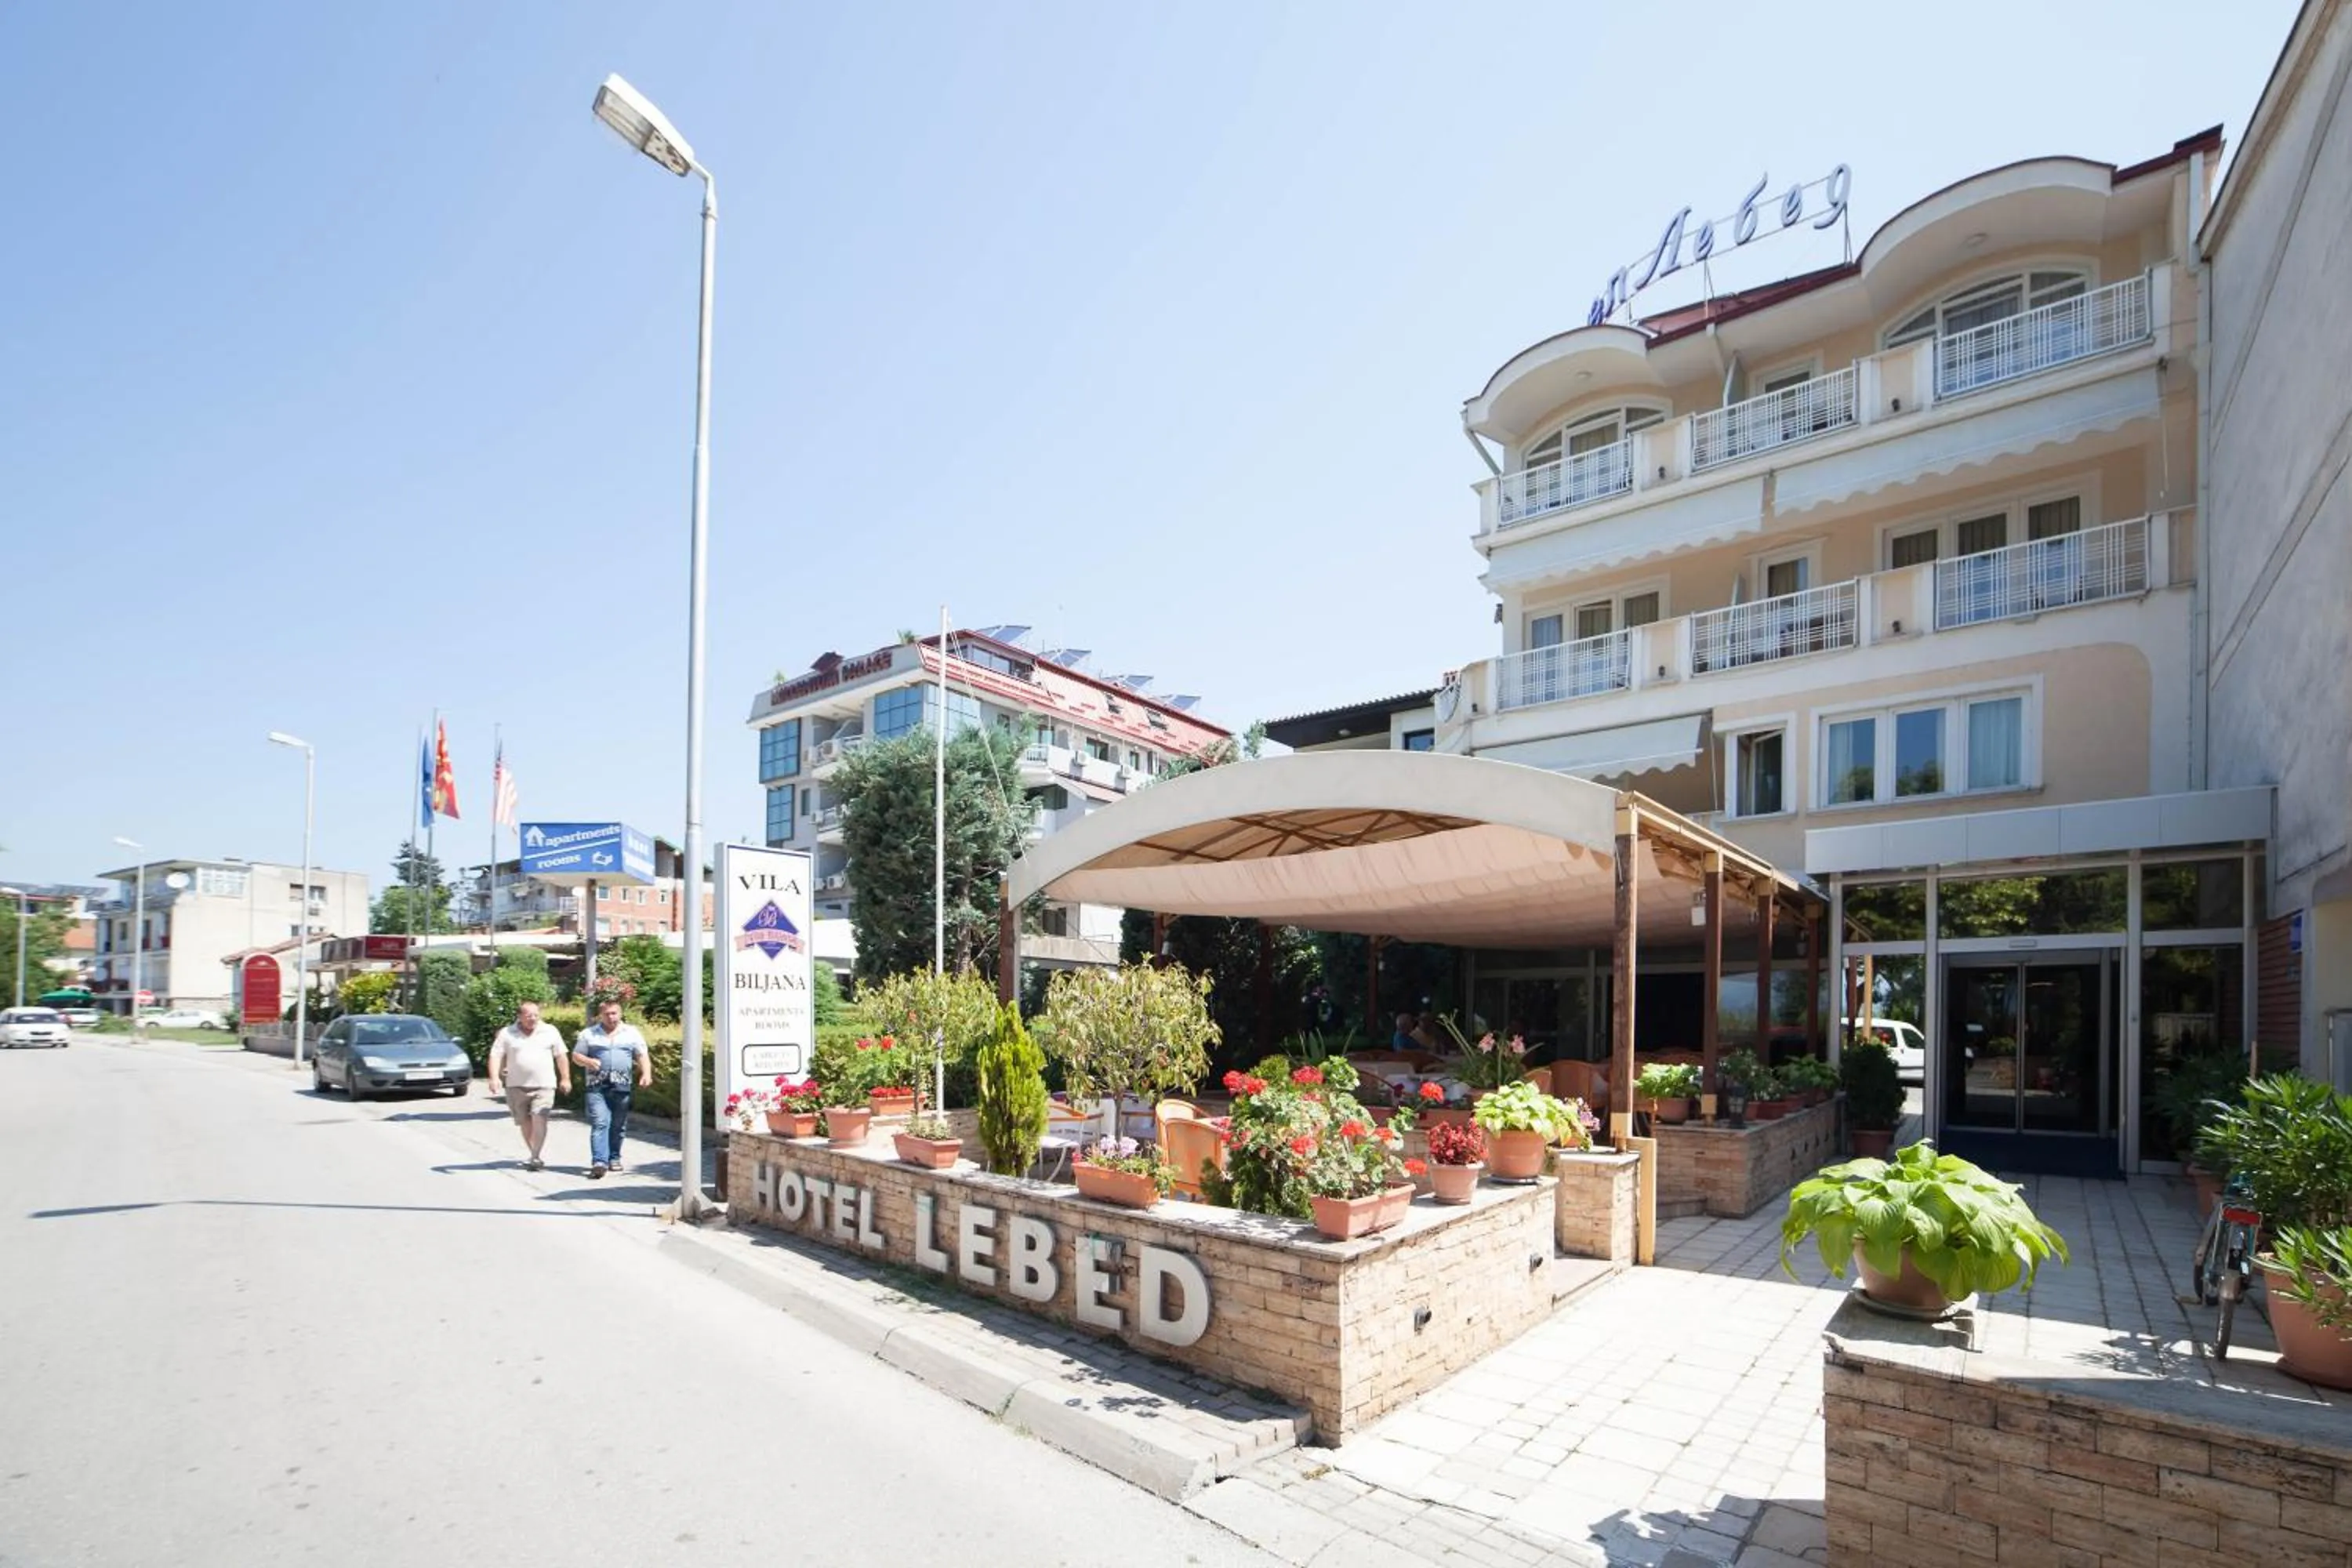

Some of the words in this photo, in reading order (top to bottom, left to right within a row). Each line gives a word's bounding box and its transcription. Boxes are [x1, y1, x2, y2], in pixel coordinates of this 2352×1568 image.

[545, 825, 621, 848] apartments
[537, 854, 582, 869] rooms
[739, 873, 801, 895] VILA
[734, 972, 807, 994] BILJANA
[752, 1164, 885, 1250] HOTEL
[914, 1194, 1211, 1348] LEBED
